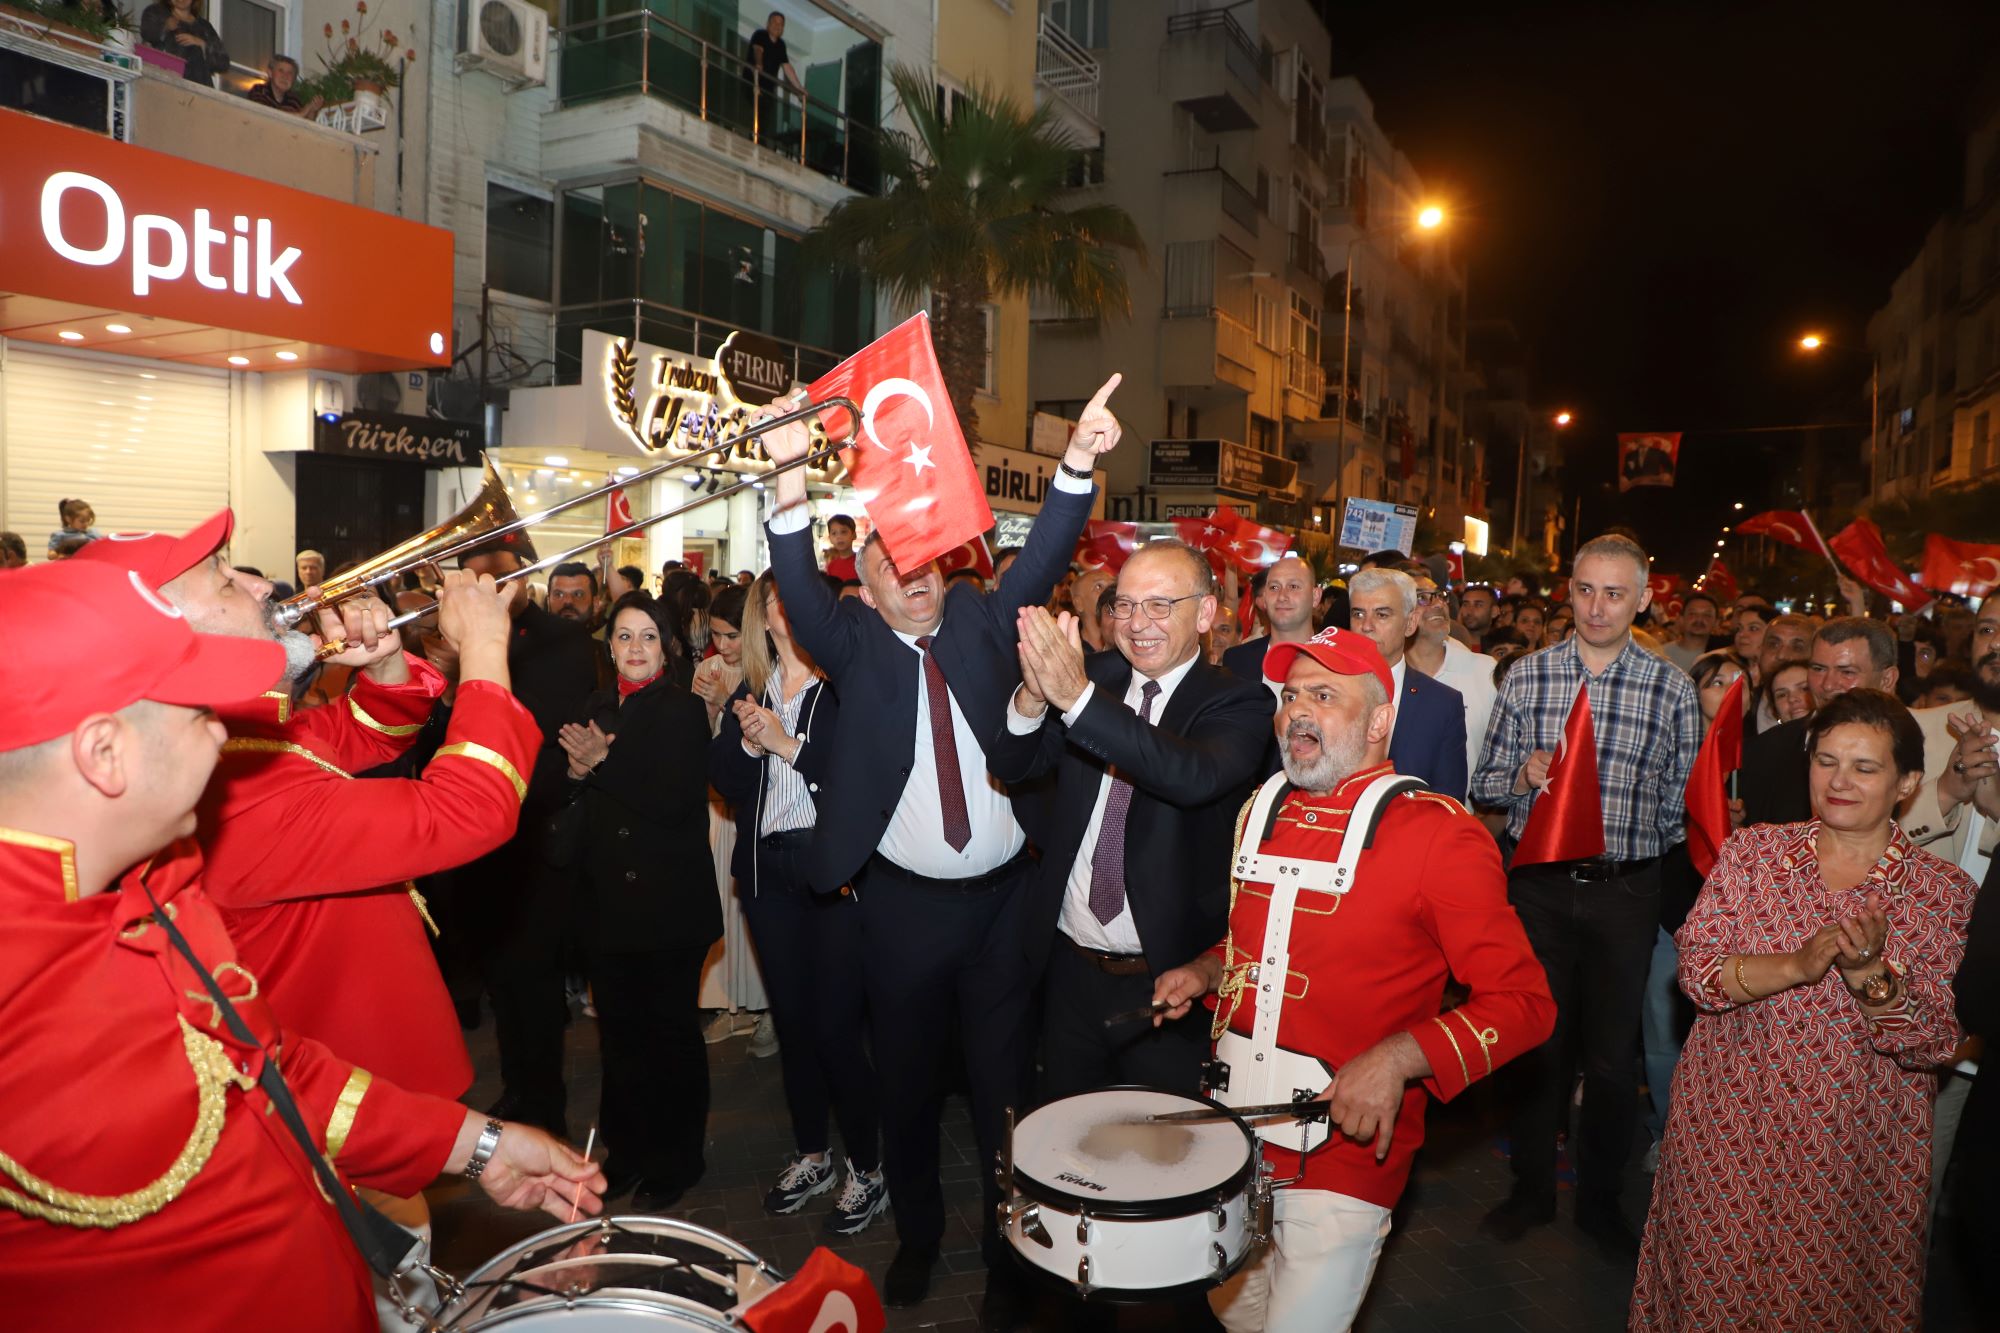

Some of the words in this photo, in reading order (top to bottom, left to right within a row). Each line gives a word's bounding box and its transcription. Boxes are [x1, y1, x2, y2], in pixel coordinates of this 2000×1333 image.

[41, 171, 303, 305] Optik
[659, 357, 719, 396] Trabzon
[733, 350, 786, 388] FIRIN
[341, 420, 467, 463] Türkşen
[1348, 507, 1364, 519] 742
